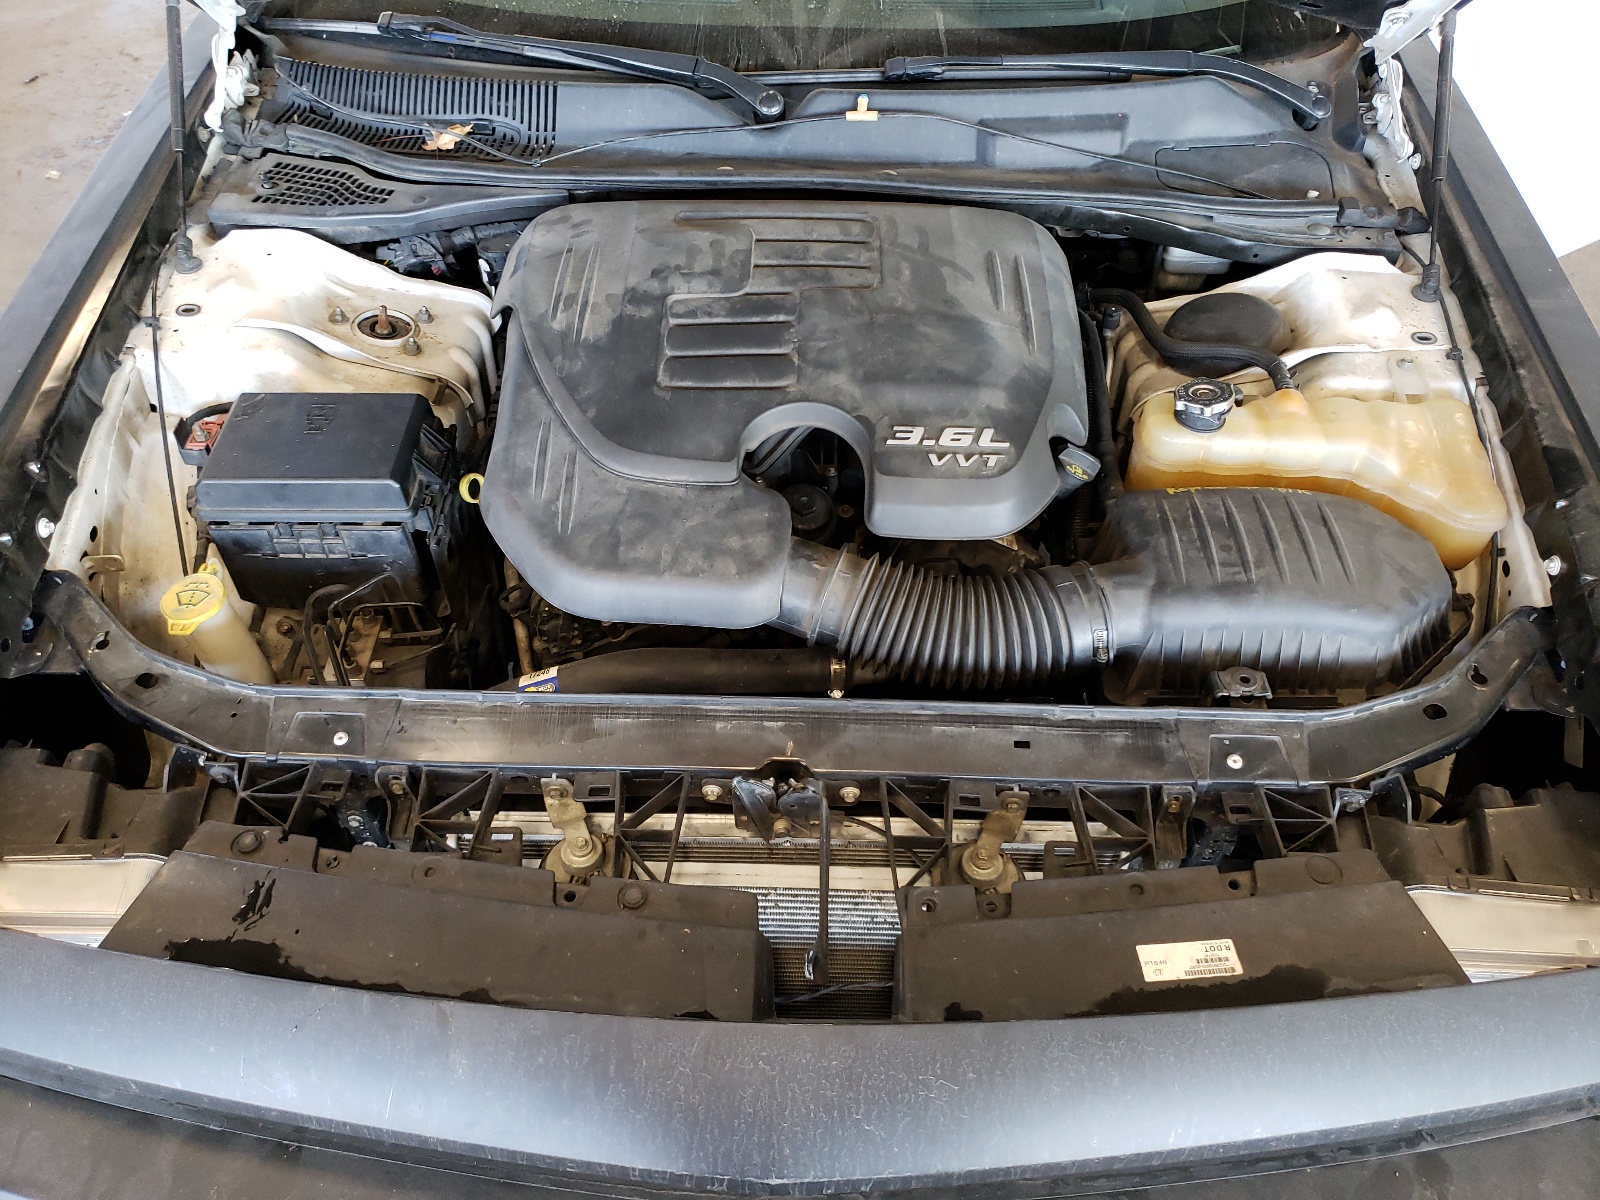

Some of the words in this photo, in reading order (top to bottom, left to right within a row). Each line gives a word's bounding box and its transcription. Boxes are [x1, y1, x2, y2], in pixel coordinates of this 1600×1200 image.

[885, 426, 1010, 448] 3.6L
[927, 453, 1006, 468] VVT
[1204, 945, 1223, 953] DOT
